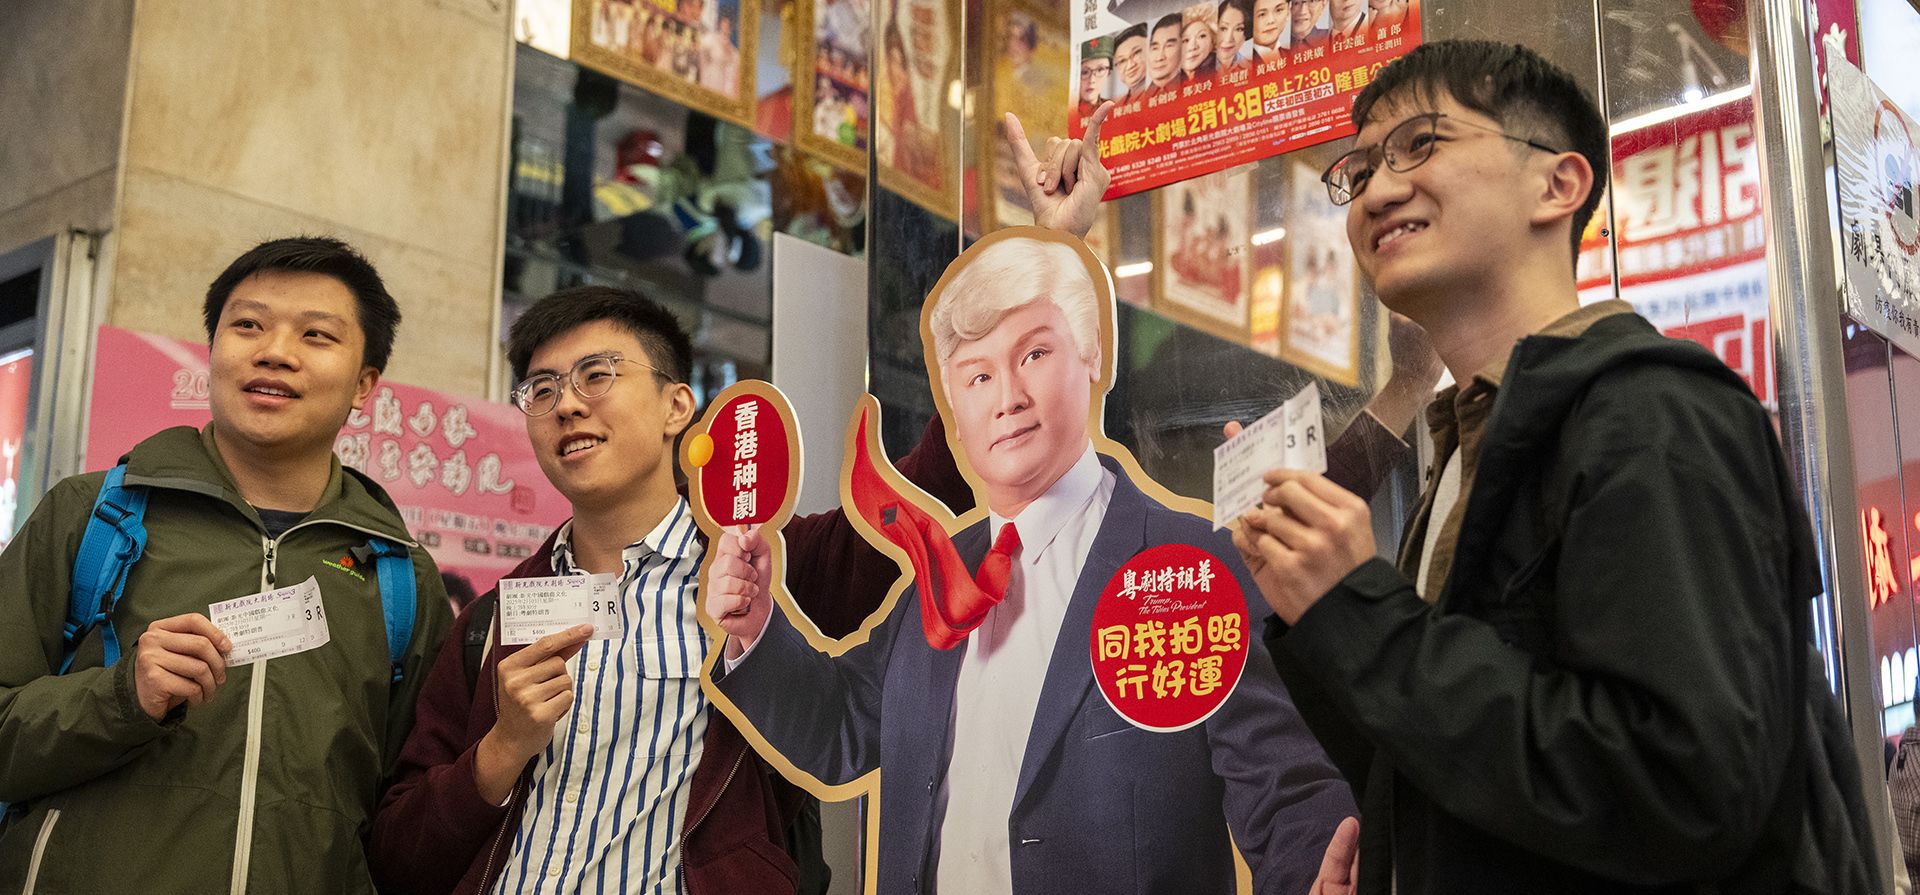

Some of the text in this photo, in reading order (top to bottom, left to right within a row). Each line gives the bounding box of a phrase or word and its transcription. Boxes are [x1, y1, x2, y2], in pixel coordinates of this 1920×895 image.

[1262, 67, 1331, 99] 晚上7:30
[1265, 85, 1334, 112] 大年初四至初六
[1287, 424, 1317, 449] 3 R
[733, 400, 759, 521] 香港神劇
[322, 559, 350, 572] weather
[1116, 559, 1216, 601] 粵劇特朗普
[305, 605, 323, 621] 3 R
[592, 601, 617, 615] 3 R
[1138, 606, 1151, 616] The
[1170, 600, 1208, 614] President
[1097, 613, 1242, 662] 同我拍照
[1115, 655, 1224, 700] 行好運
